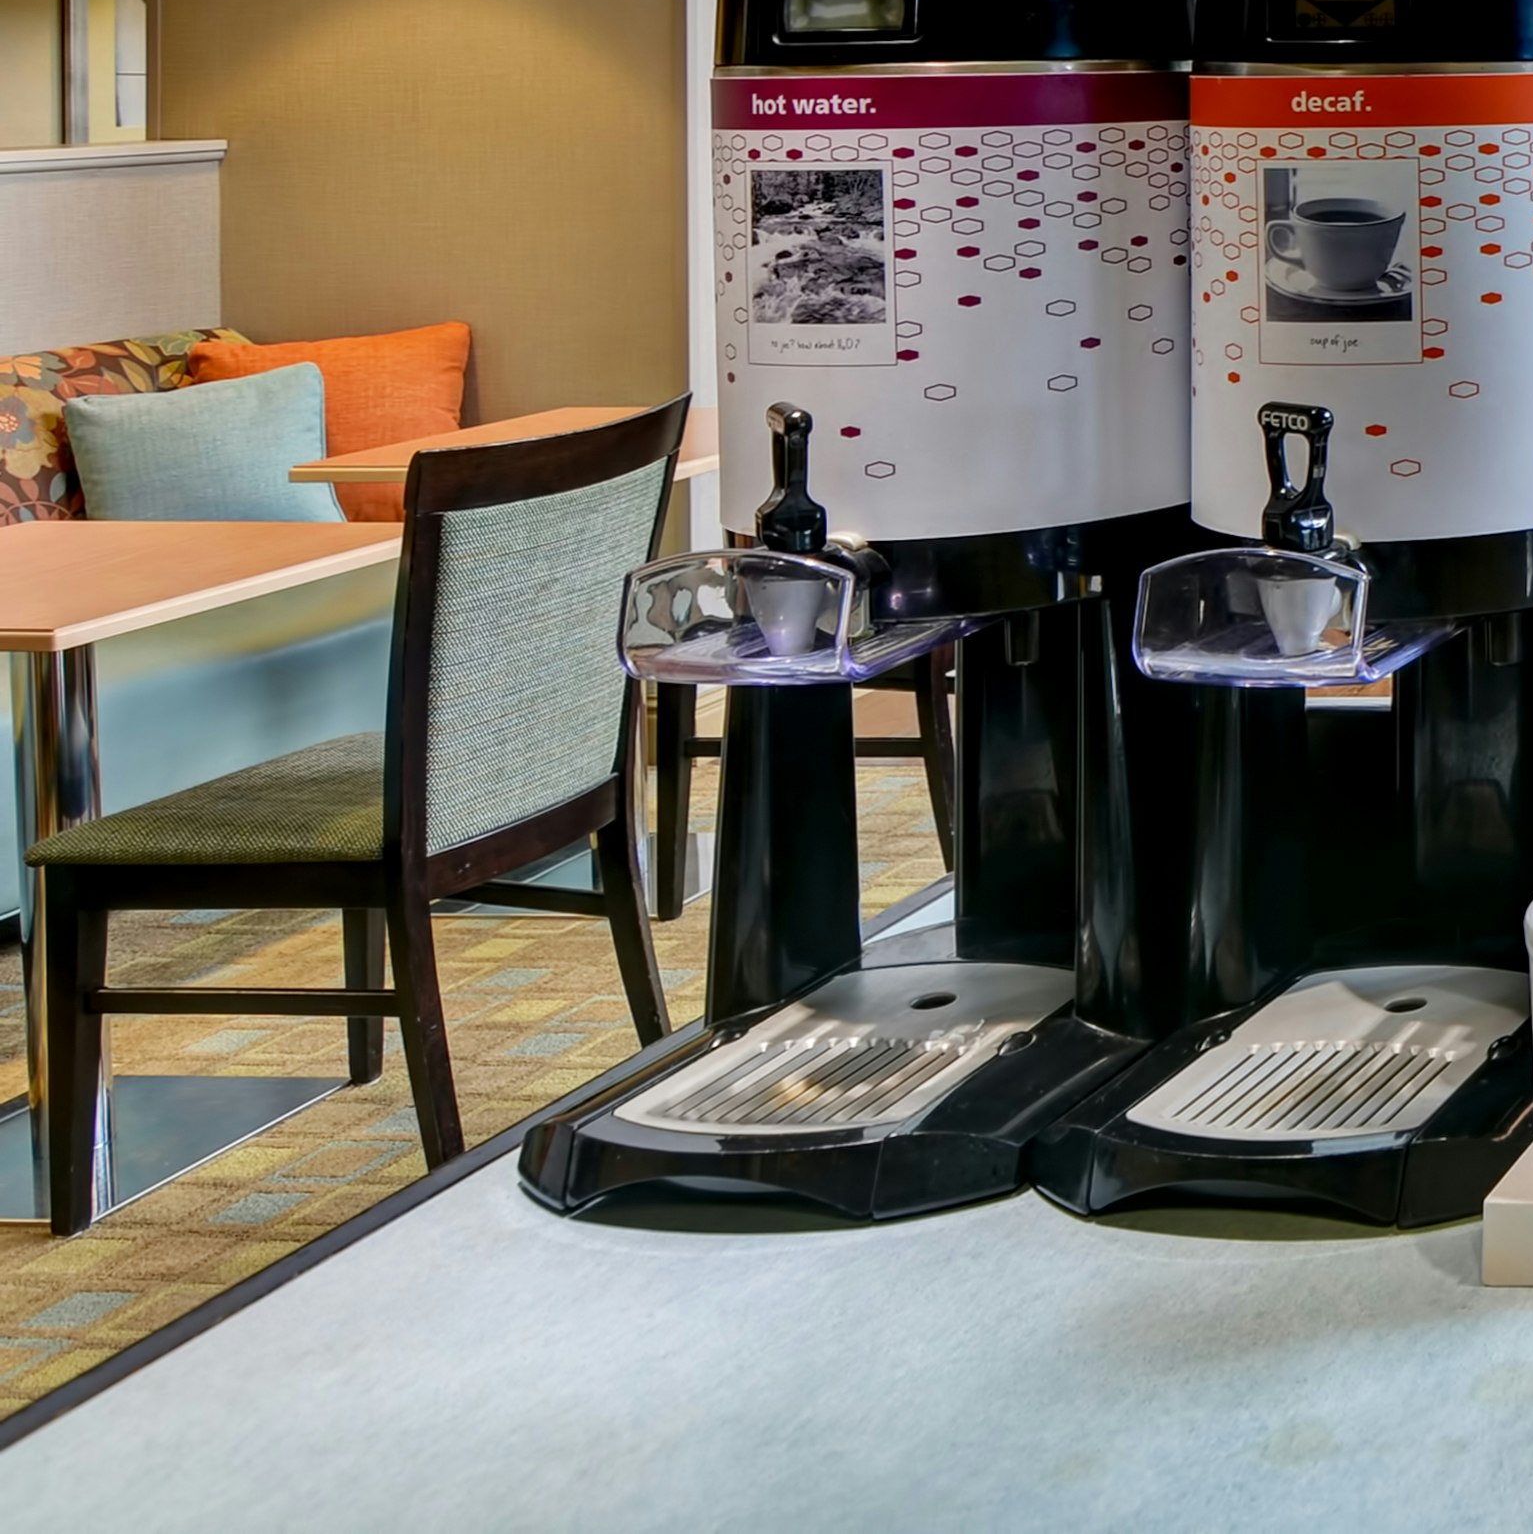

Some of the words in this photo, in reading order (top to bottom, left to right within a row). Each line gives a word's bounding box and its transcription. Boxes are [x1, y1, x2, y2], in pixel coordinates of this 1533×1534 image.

[752, 93, 787, 115] hot
[792, 94, 877, 115] water.
[1291, 90, 1373, 113] decaf.
[1261, 411, 1309, 431] FETCO
